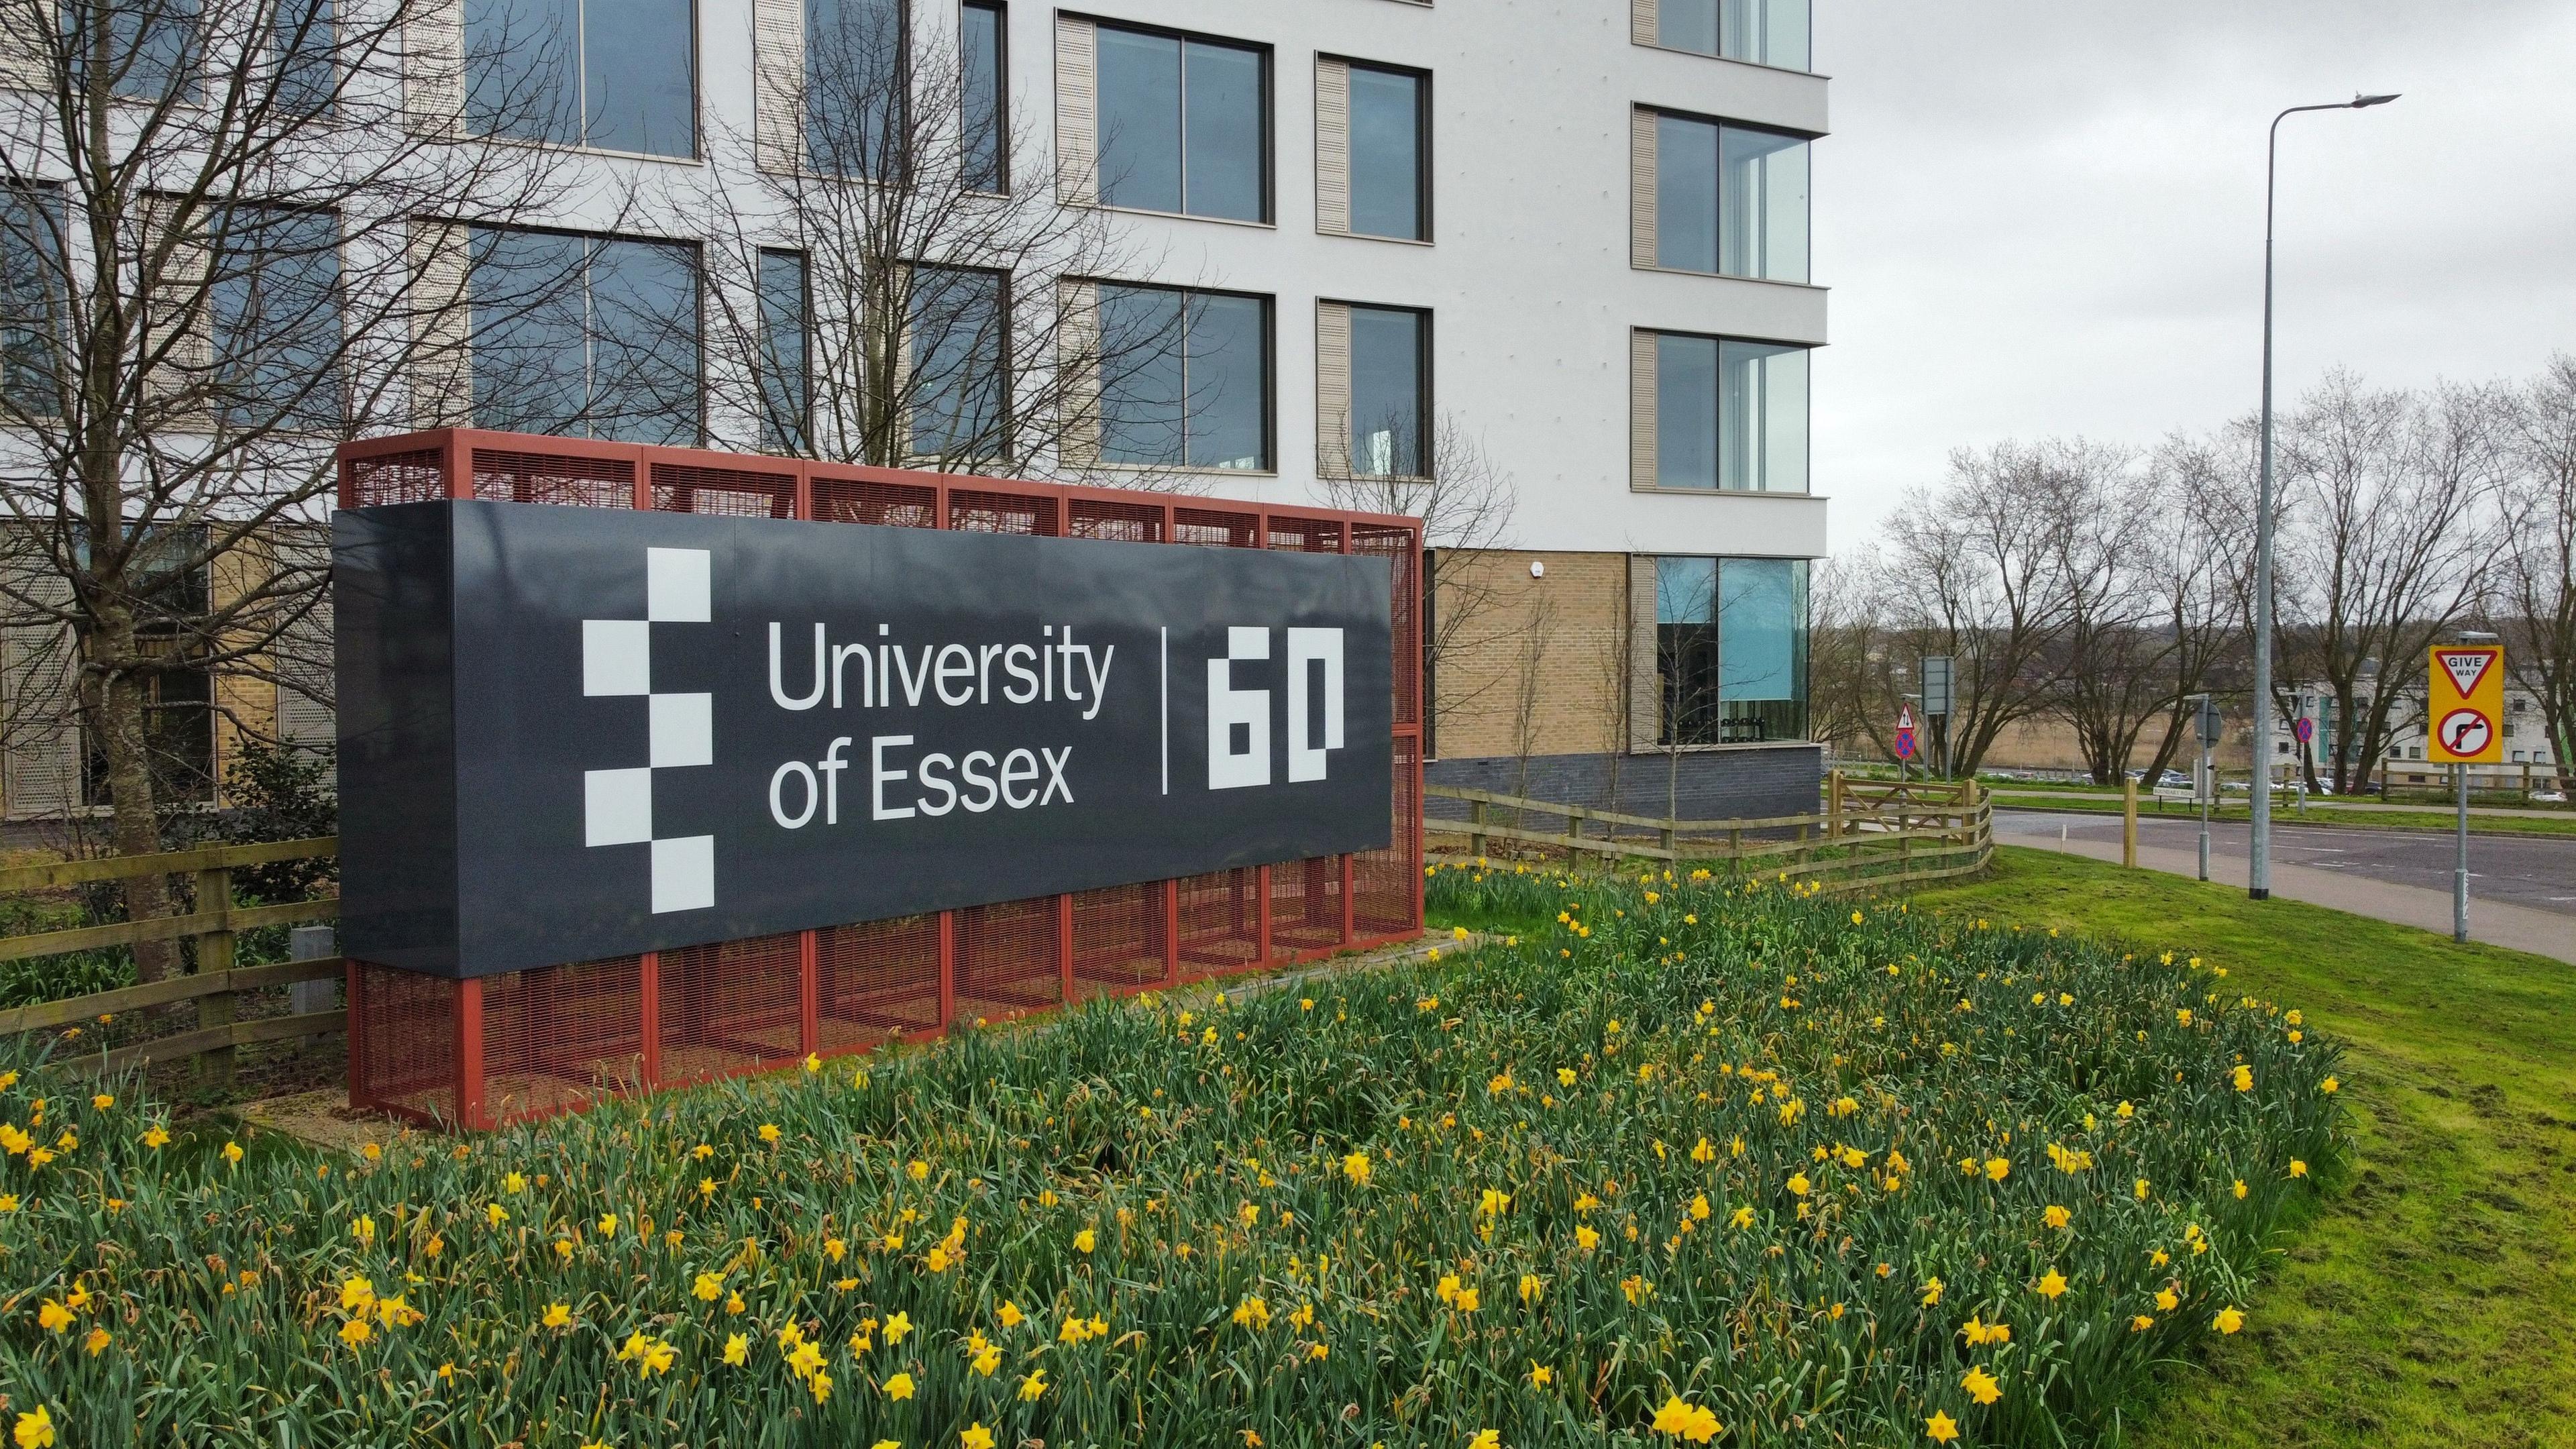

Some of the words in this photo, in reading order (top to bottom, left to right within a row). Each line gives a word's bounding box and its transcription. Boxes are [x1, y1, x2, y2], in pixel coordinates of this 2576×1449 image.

[769, 622, 1115, 720] University
[1208, 626, 1344, 790] 60
[2449, 657, 2482, 667] GIVE
[769, 737, 852, 829] of
[872, 735, 1075, 821] Essex
